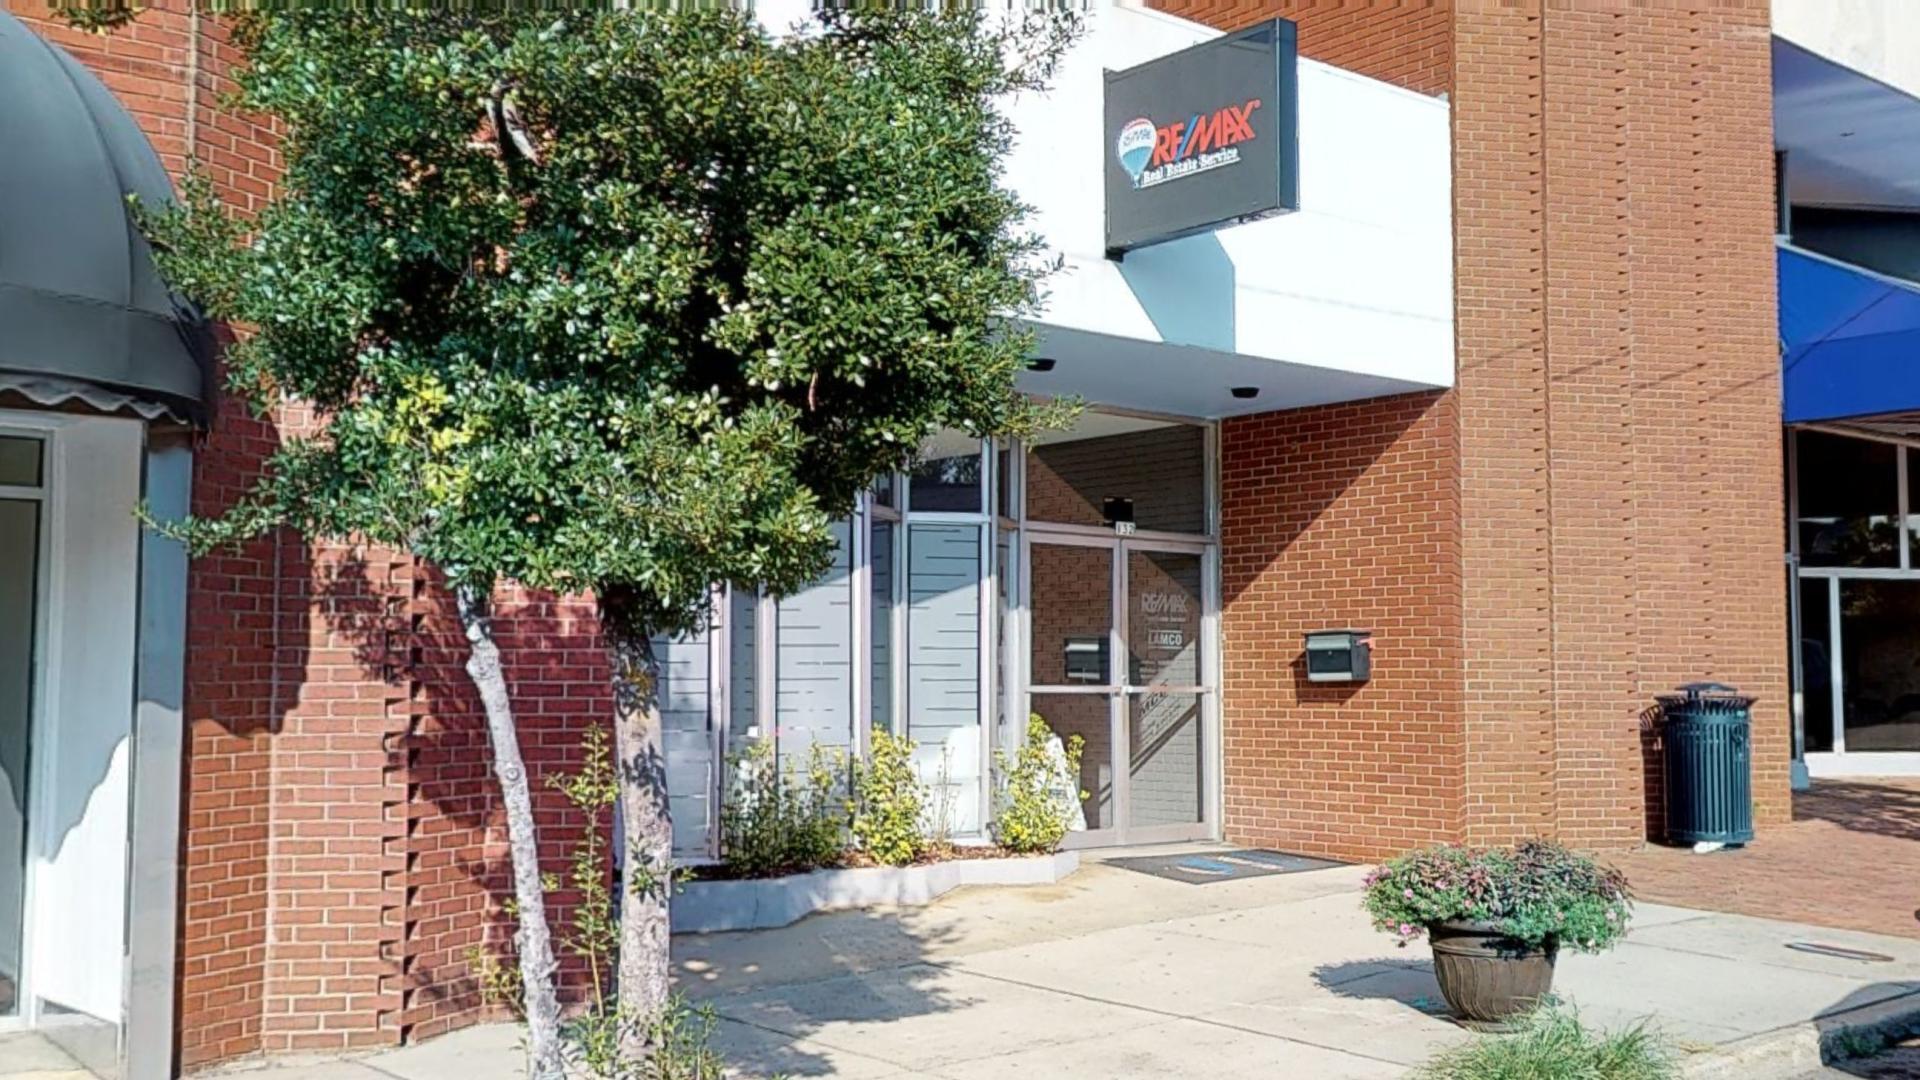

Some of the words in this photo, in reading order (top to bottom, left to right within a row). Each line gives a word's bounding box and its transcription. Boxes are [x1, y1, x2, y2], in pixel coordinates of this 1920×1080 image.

[1153, 101, 1257, 166] RE/MAX
[1143, 167, 1164, 182] Real
[1167, 157, 1198, 177] Estate
[1199, 147, 1239, 169] Service
[1117, 522, 1136, 535] 132
[1148, 634, 1183, 646] LAMCO
